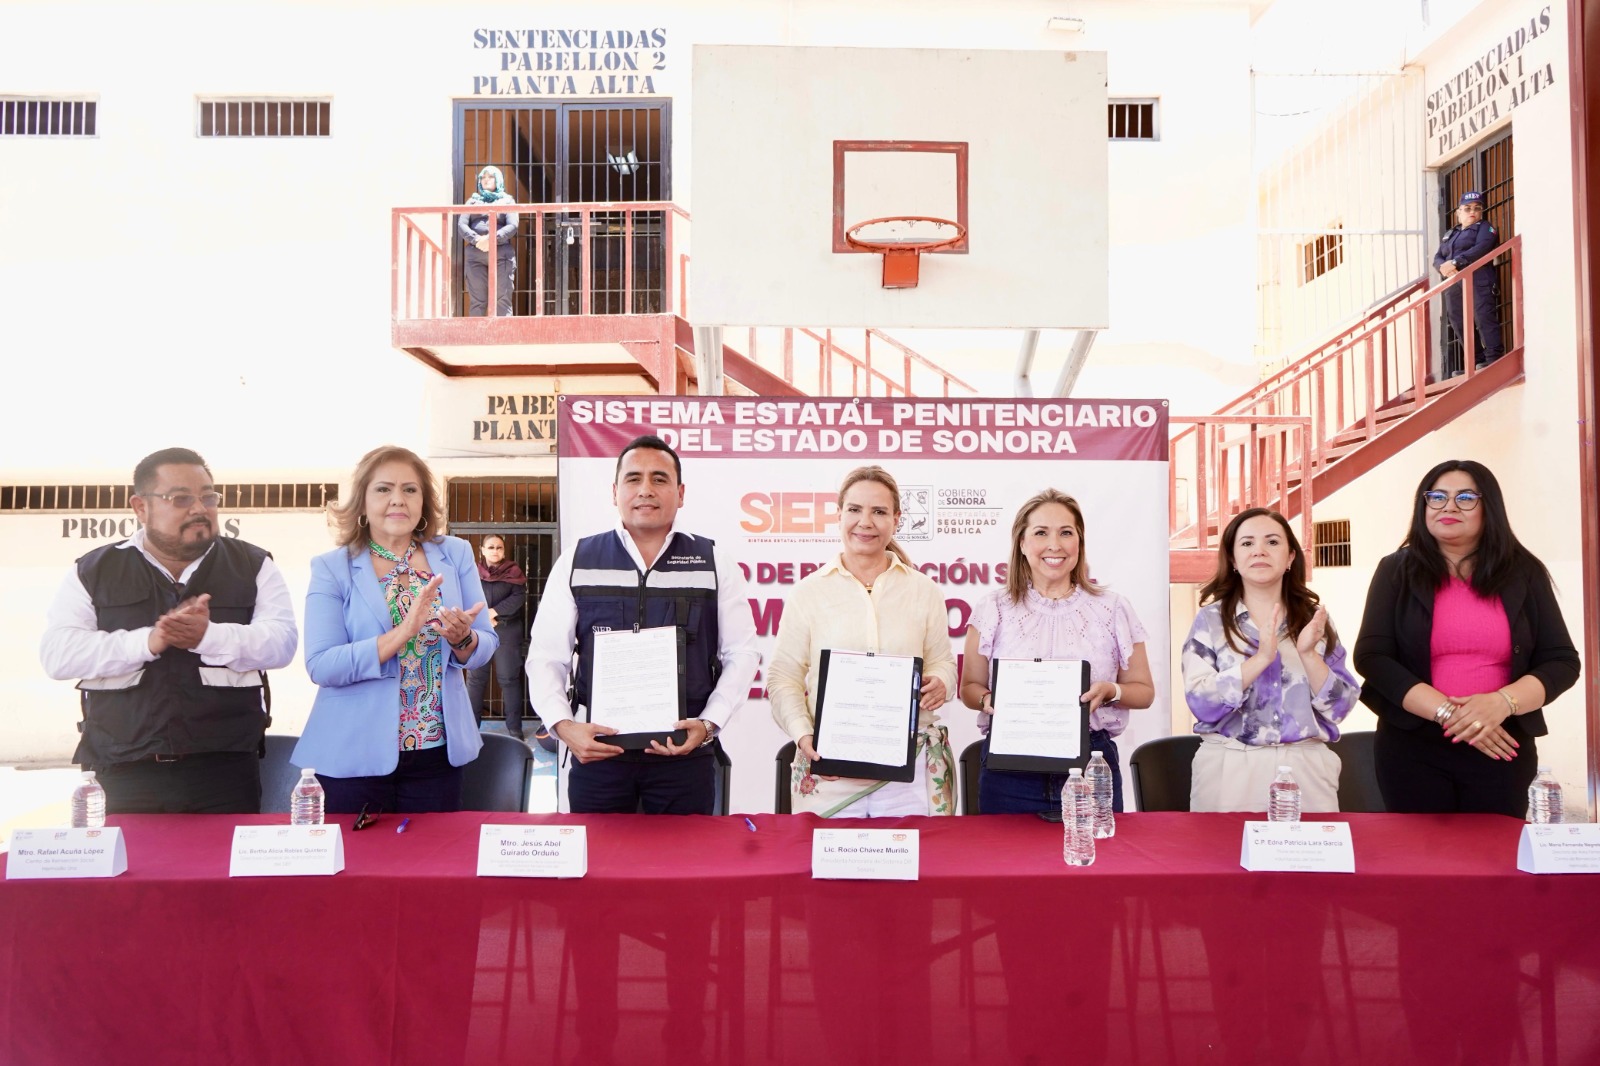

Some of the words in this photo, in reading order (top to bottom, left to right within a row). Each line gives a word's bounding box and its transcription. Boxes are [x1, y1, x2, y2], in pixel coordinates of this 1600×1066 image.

[474, 28, 666, 49] SENTENCIADAS
[501, 51, 639, 71] PABELLON
[652, 52, 666, 70] 2
[1426, 5, 1550, 117] SENTENCIADAS
[473, 76, 578, 95] PLANTA
[590, 75, 656, 94] ALTA
[1438, 99, 1500, 156] PLANTA
[1507, 62, 1555, 112] ALTA
[487, 396, 555, 415] PABE
[571, 401, 725, 424] SISTEMA
[735, 402, 884, 426] ESTATAL
[893, 403, 1158, 428] PENITENCIARIO
[473, 420, 556, 440] PLANT
[656, 428, 722, 451] DEL
[732, 429, 868, 452] ESTADO
[878, 430, 922, 452] DE
[932, 430, 1078, 454] SONORA
[938, 489, 987, 497] GOBIERNO
[740, 492, 840, 534] SIEP
[756, 562, 794, 584] DE
